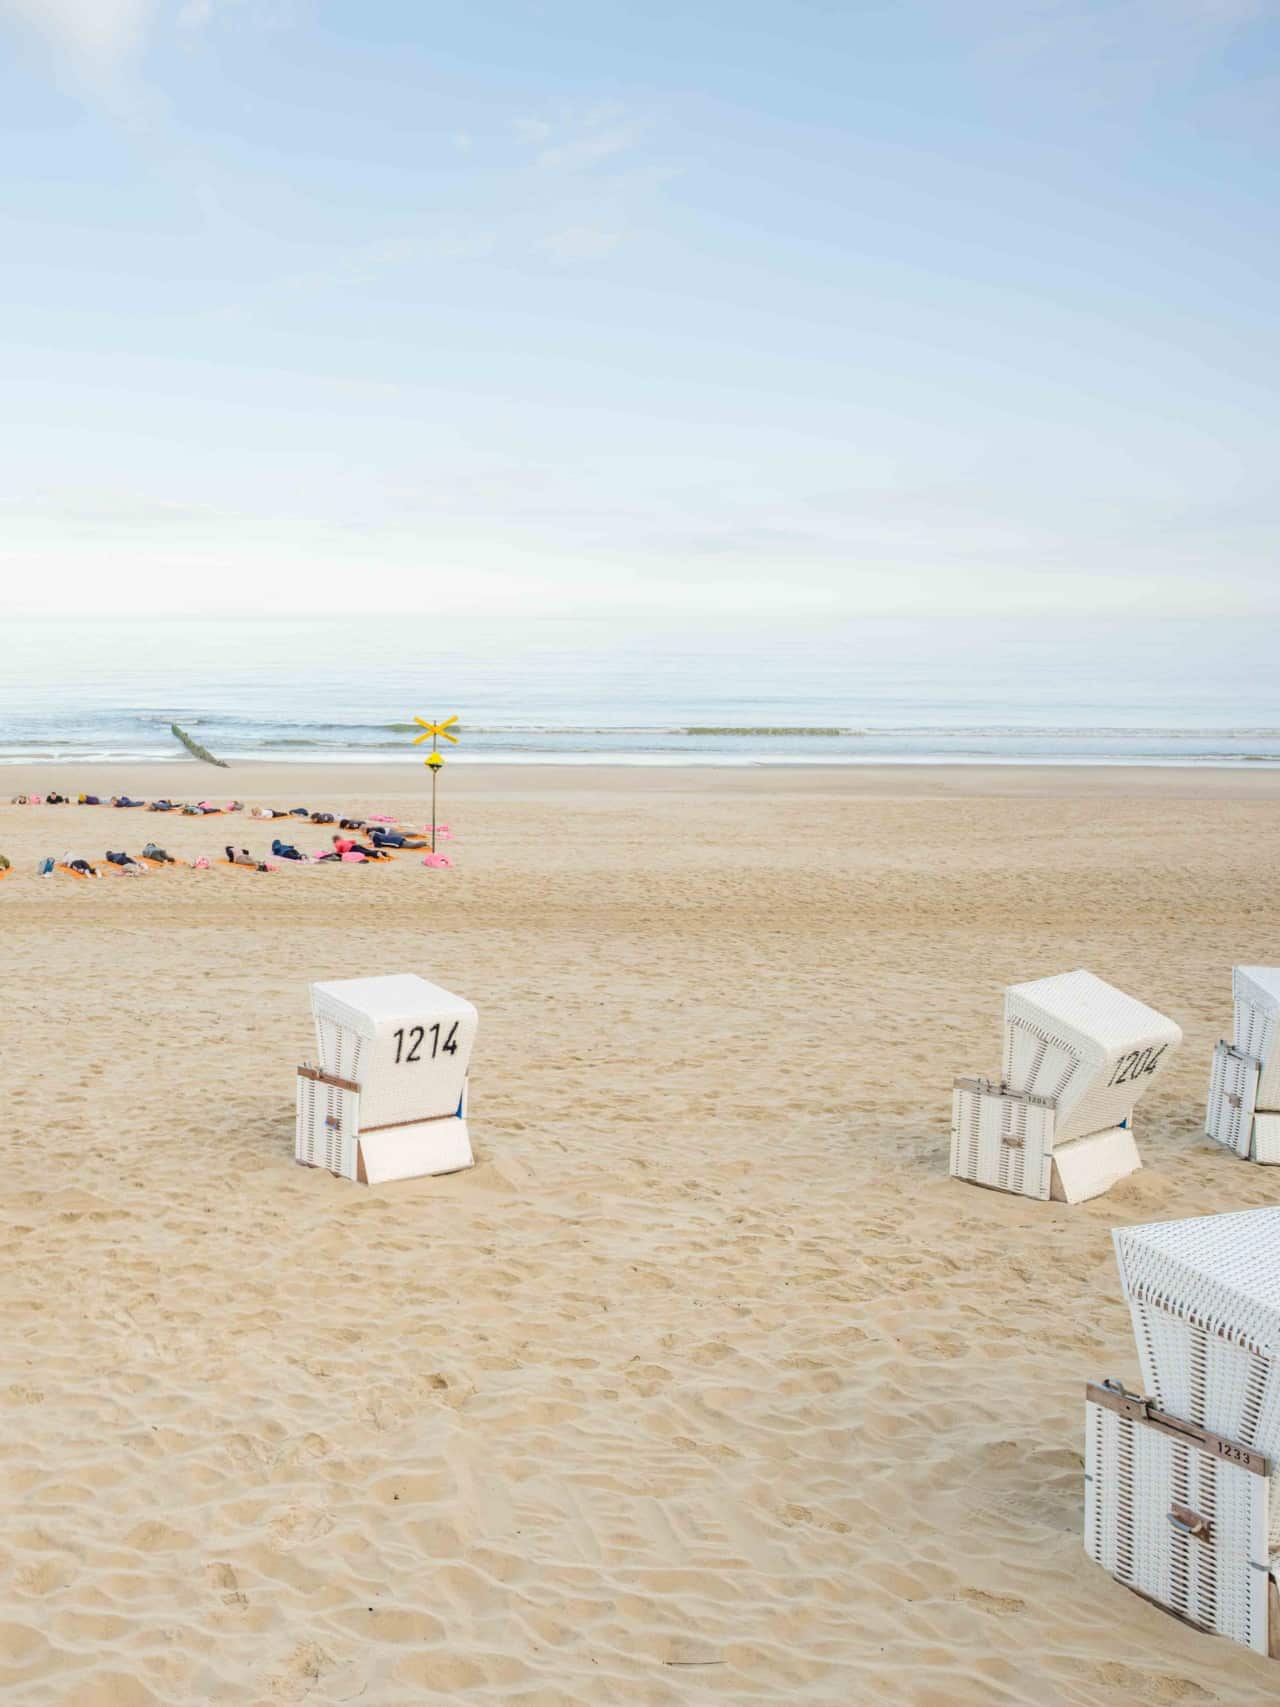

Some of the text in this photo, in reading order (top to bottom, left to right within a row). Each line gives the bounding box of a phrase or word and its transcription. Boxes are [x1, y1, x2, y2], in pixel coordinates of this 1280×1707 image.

[394, 1022, 458, 1063] 1214
[1108, 1044, 1168, 1086] 1204
[1217, 1441, 1251, 1465] 1233
